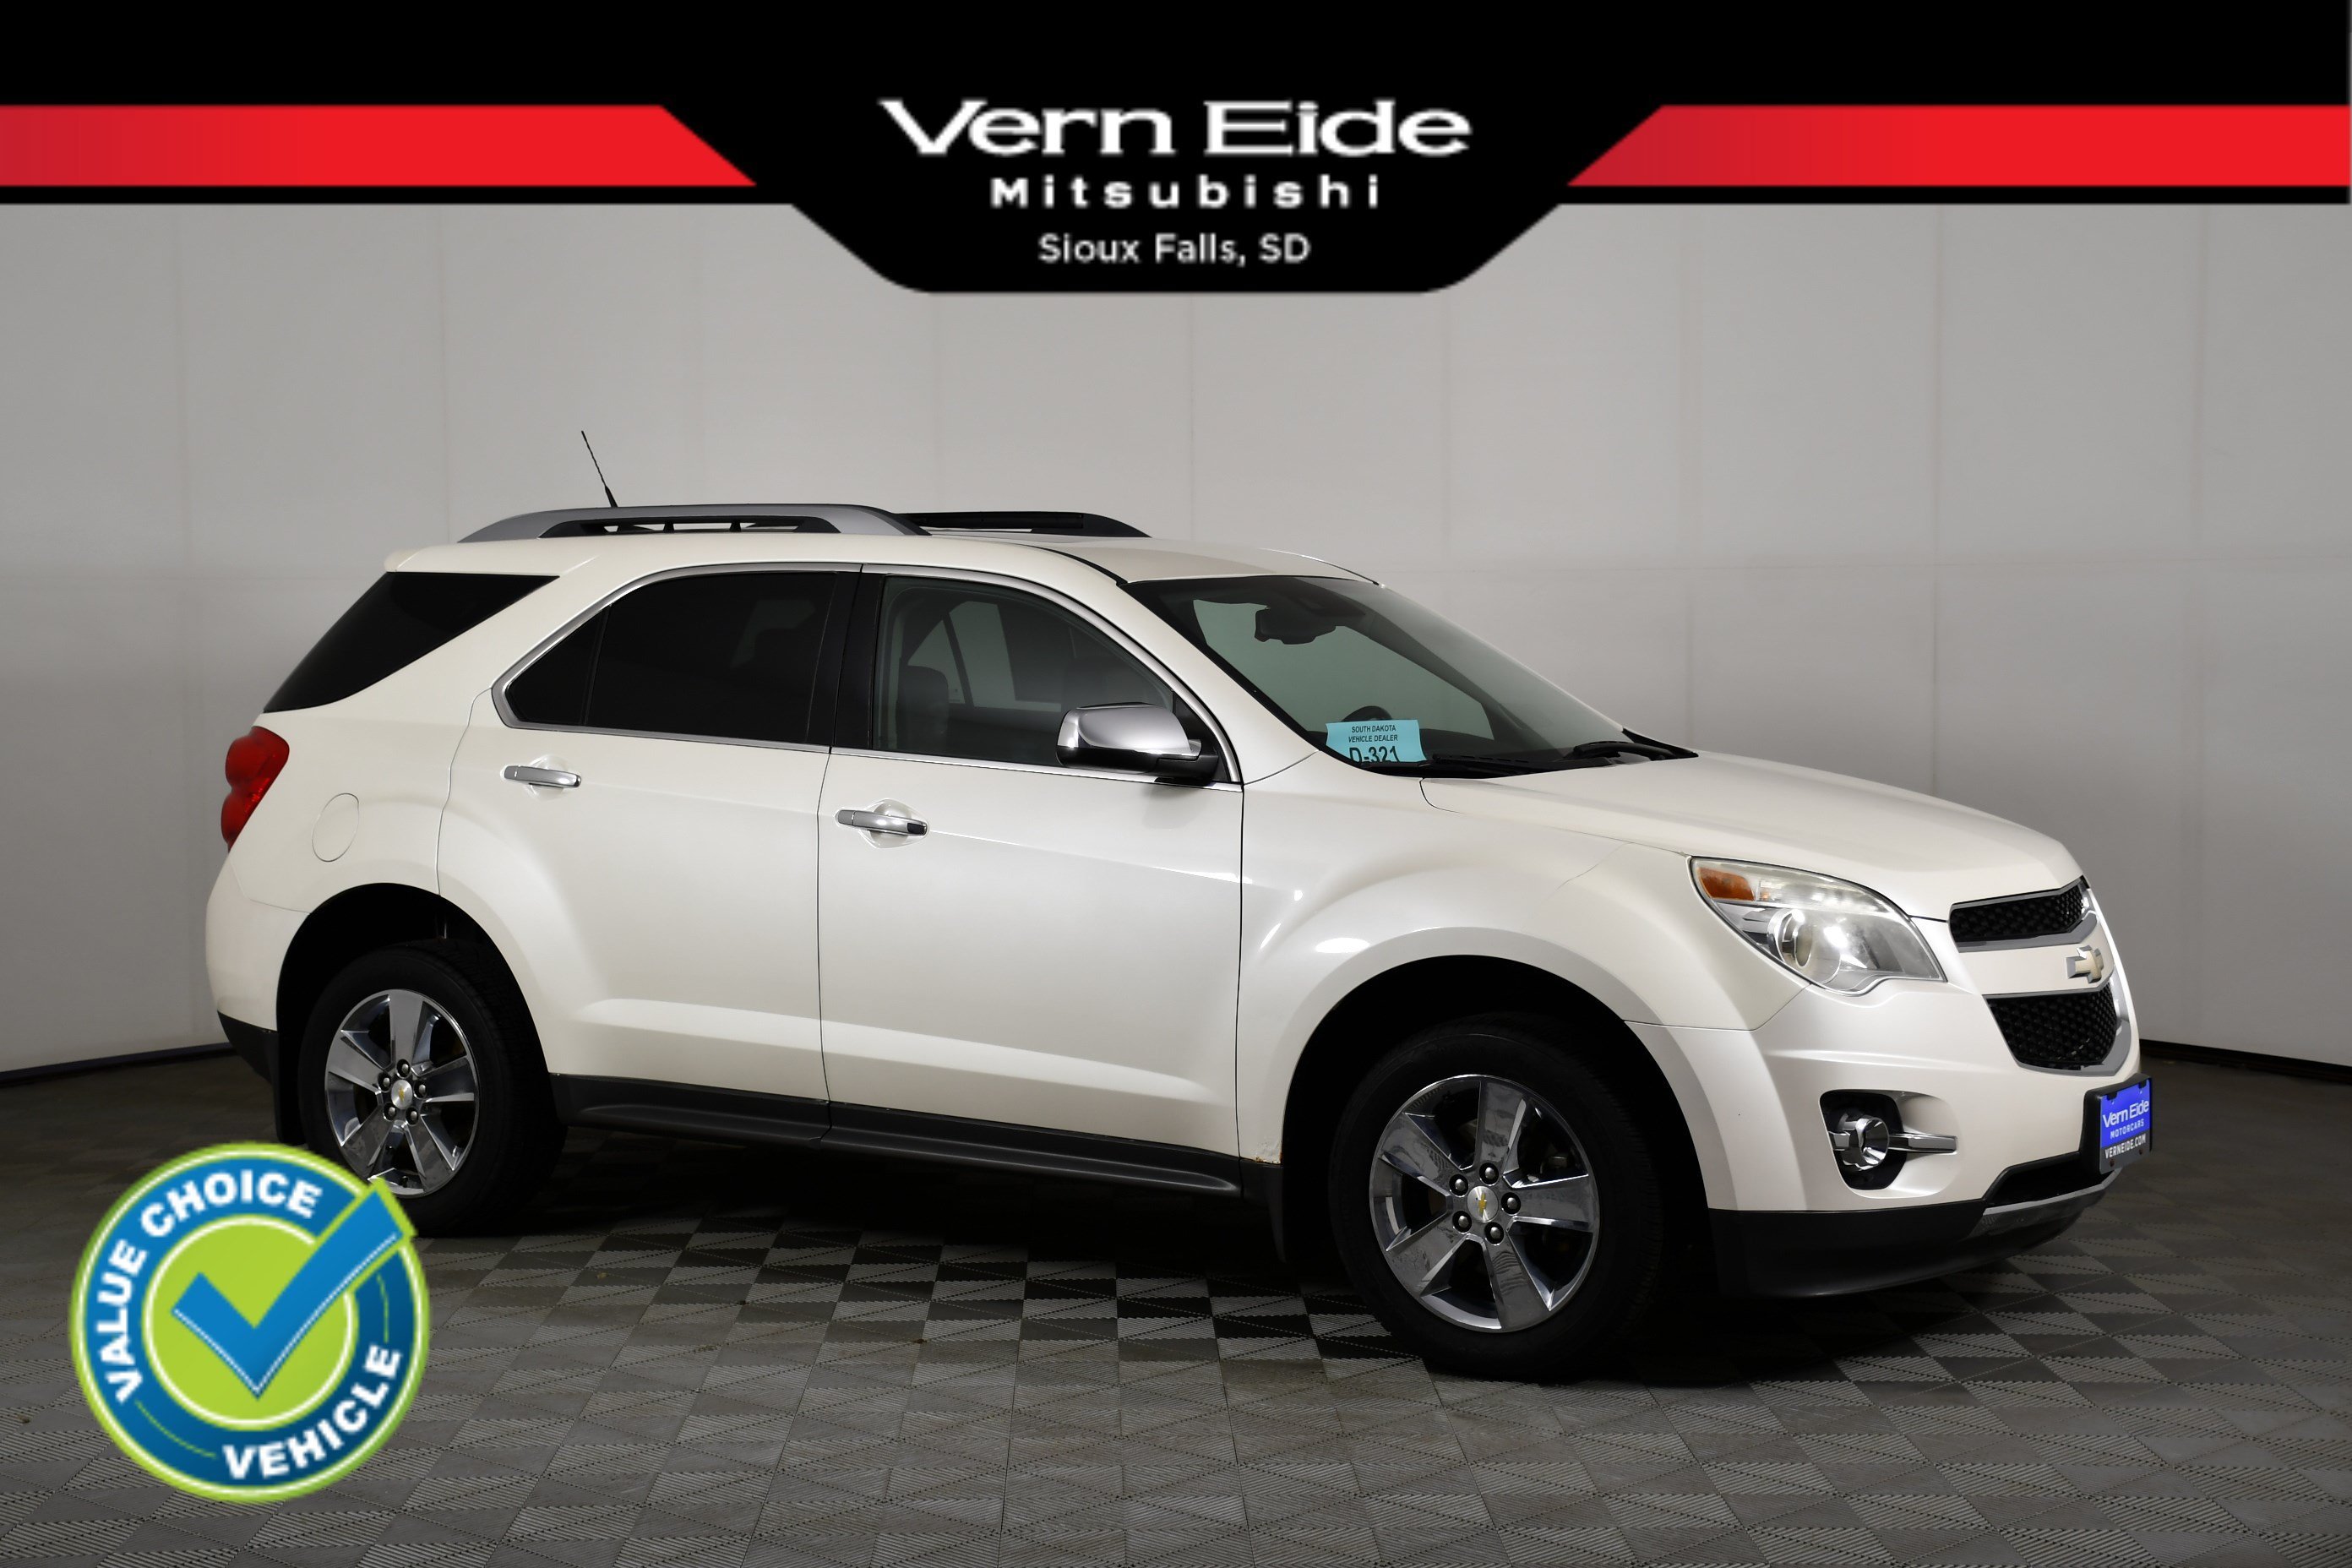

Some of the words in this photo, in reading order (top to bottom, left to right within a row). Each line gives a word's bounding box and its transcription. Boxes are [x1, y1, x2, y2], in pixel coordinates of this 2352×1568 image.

[1349, 746, 1400, 763] D-321
[2103, 1109, 2128, 1128] Vern
[2130, 1100, 2149, 1119] Eide
[2110, 1119, 2144, 1139] MOTORCARS
[2104, 1134, 2147, 1158] VERNEIDE.COM
